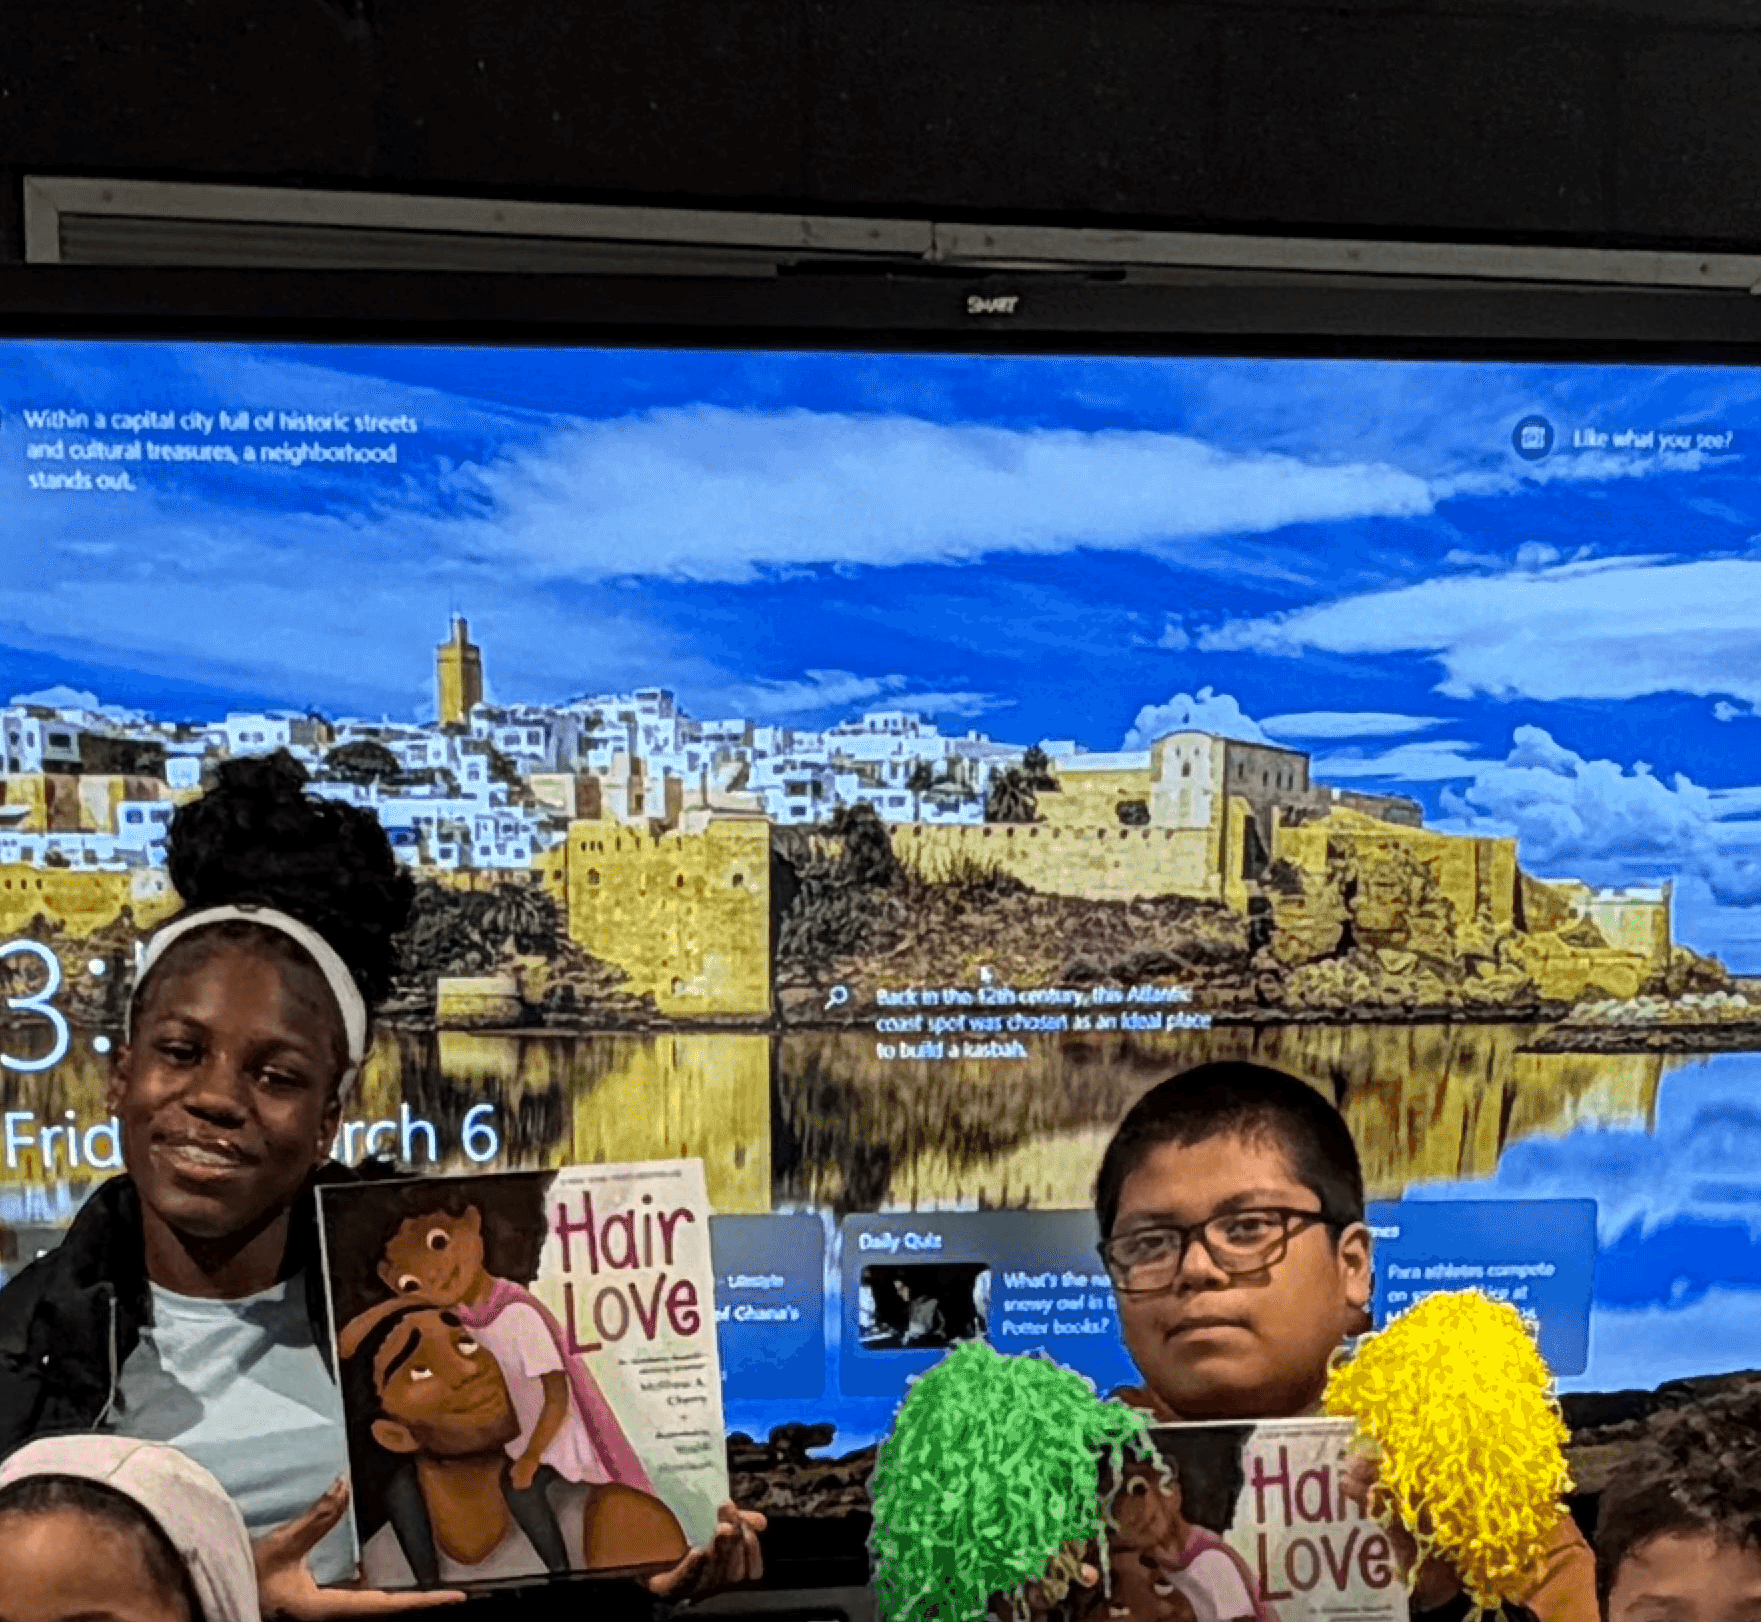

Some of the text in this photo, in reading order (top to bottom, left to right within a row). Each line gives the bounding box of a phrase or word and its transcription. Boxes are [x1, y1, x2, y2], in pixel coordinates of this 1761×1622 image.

[966, 295, 1019, 314] SMART
[24, 409, 418, 435] Within a capital city full of historic streets
[1574, 428, 1734, 454] Like what you see?
[27, 440, 397, 466] and cultural treasures, a neighborhood
[28, 470, 137, 492] stands out.
[876, 984, 1194, 1009] Back in the 12th century, this Atlantic
[876, 1011, 1213, 1036] coast spot was chosen as an ideal place
[876, 1042, 895, 1060] to
[899, 1041, 943, 1060] build
[948, 1045, 959, 1060] a
[2, 1103, 499, 1170] Frid rch 6
[554, 1190, 695, 1276] Hair
[859, 1231, 943, 1253] Daily Quiz
[1004, 1272, 1058, 1290] What's
[1061, 1272, 1088, 1289] the
[1424, 1262, 1484, 1279] athletes
[1487, 1262, 1556, 1280] compete
[563, 1272, 701, 1356] Love
[734, 1304, 800, 1322] Ghana's
[1088, 1295, 1103, 1311] in
[1003, 1317, 1111, 1336] Potter books?
[1257, 1526, 1394, 1602] Love
